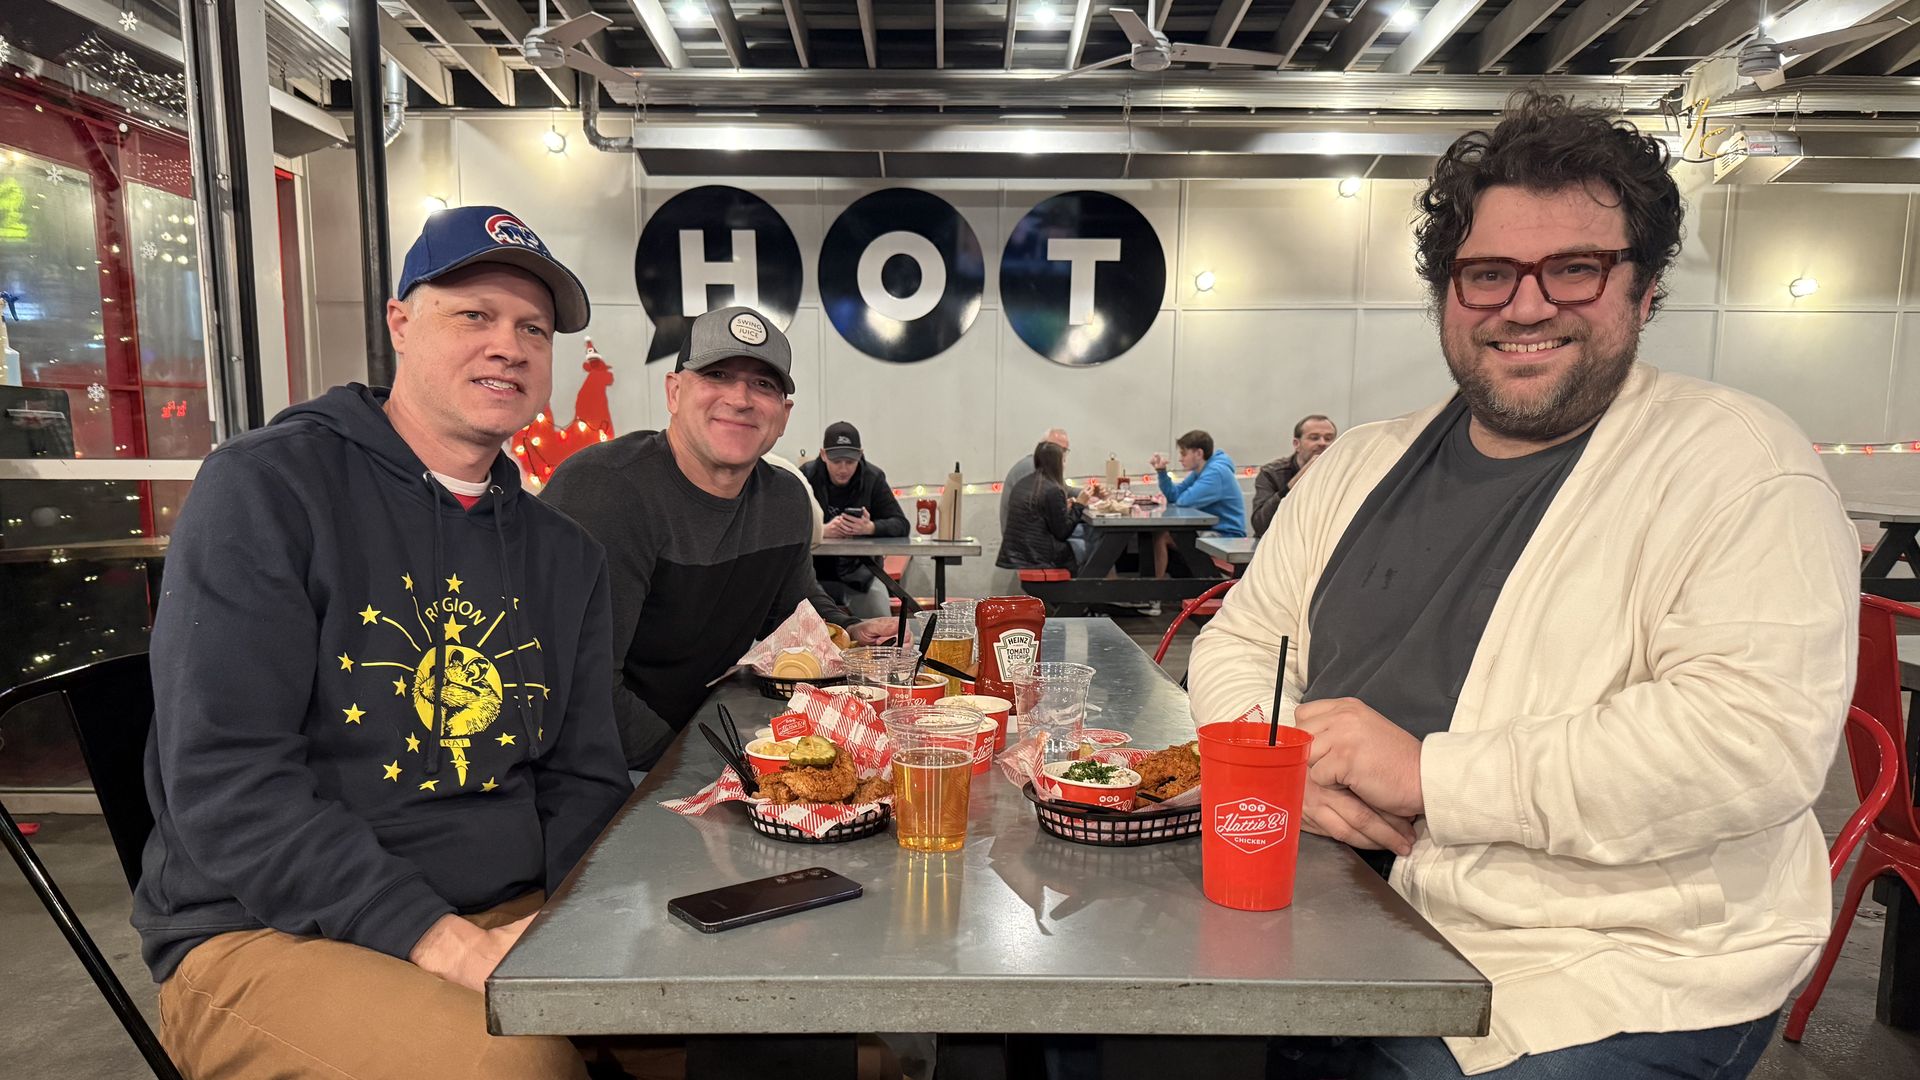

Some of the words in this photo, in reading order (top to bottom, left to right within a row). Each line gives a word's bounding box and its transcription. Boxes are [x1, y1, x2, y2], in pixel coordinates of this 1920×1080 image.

[679, 229, 1122, 326] HOT
[737, 319, 762, 330] SWING
[739, 328, 759, 338] JUICE
[1008, 636, 1029, 645] HEINZ
[1006, 647, 1030, 655] TOMATO
[1239, 803, 1266, 812] HOT
[1217, 813, 1267, 833] Hattie
[1268, 812, 1287, 829] B's
[1234, 837, 1267, 845] CHICKEN
